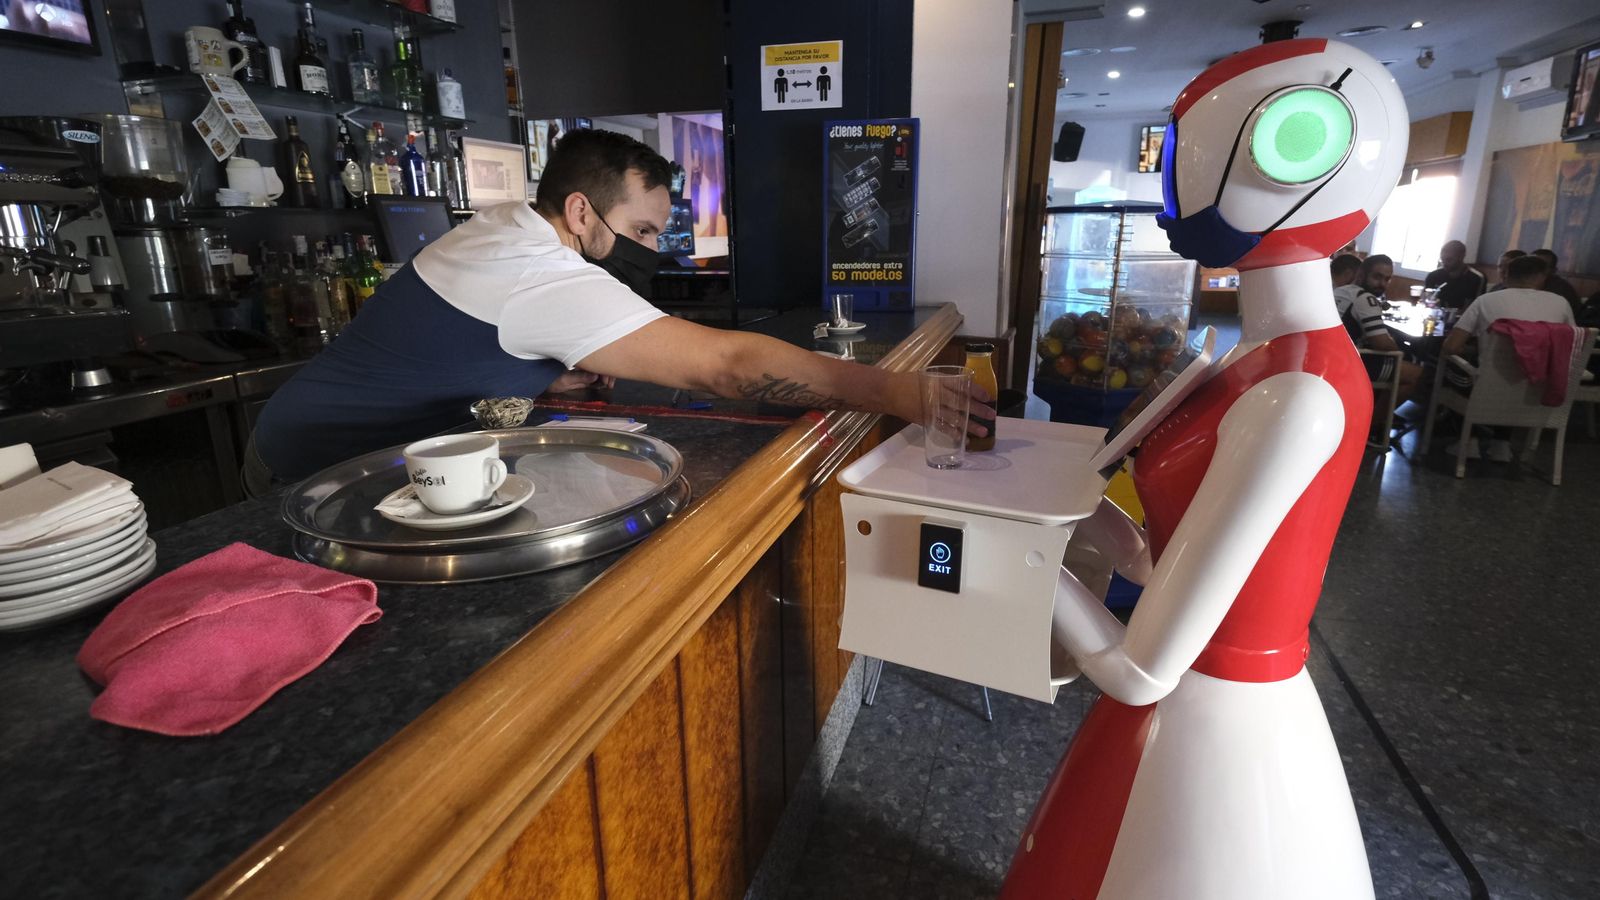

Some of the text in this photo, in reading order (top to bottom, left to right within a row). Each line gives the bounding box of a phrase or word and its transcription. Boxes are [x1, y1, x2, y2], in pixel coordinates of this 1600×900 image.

[866, 124, 897, 139] fuego?
[832, 262, 903, 270] encendedores extra
[831, 269, 903, 280] 50 modelos
[928, 564, 951, 574] EXIT
